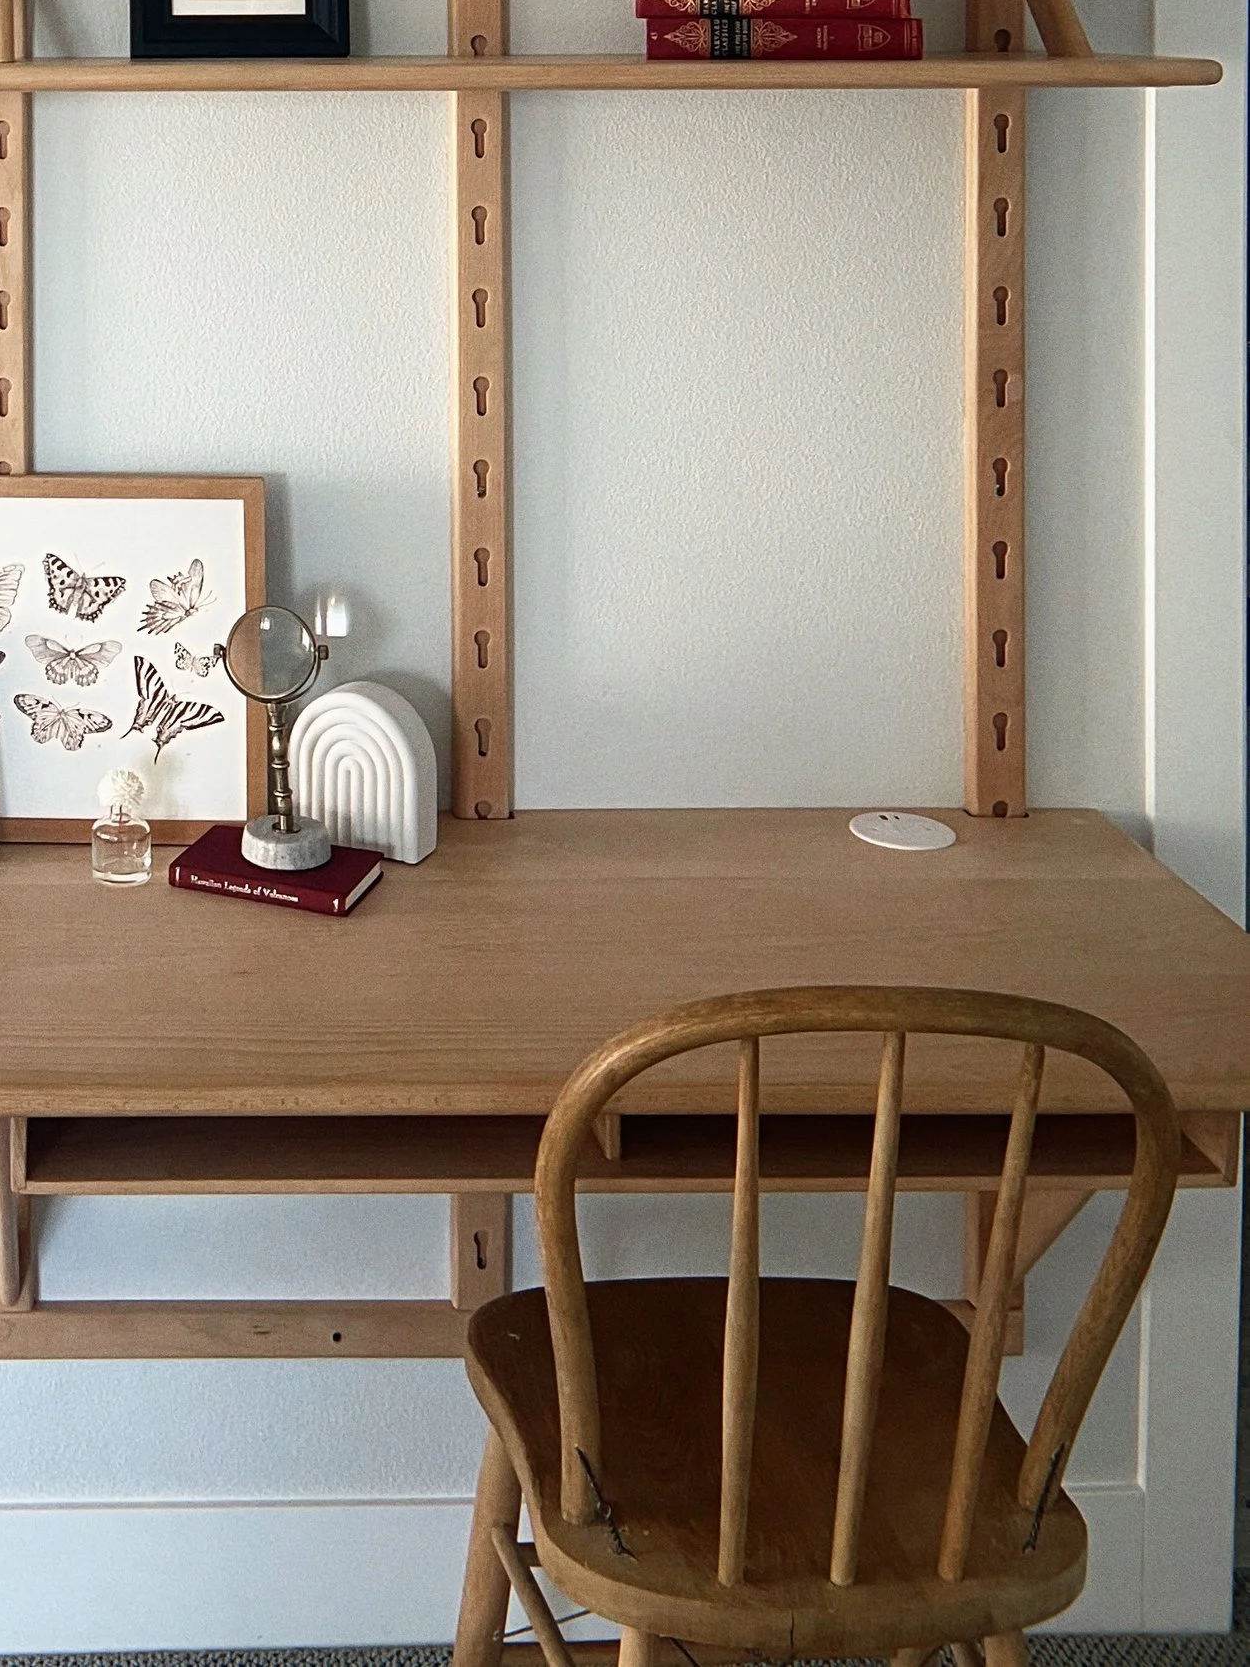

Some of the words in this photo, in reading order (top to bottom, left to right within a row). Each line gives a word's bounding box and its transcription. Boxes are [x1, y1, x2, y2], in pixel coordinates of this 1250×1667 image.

[224, 881, 251, 894] Legends
[253, 886, 262, 896] of
[263, 887, 299, 903] Volcanoes
